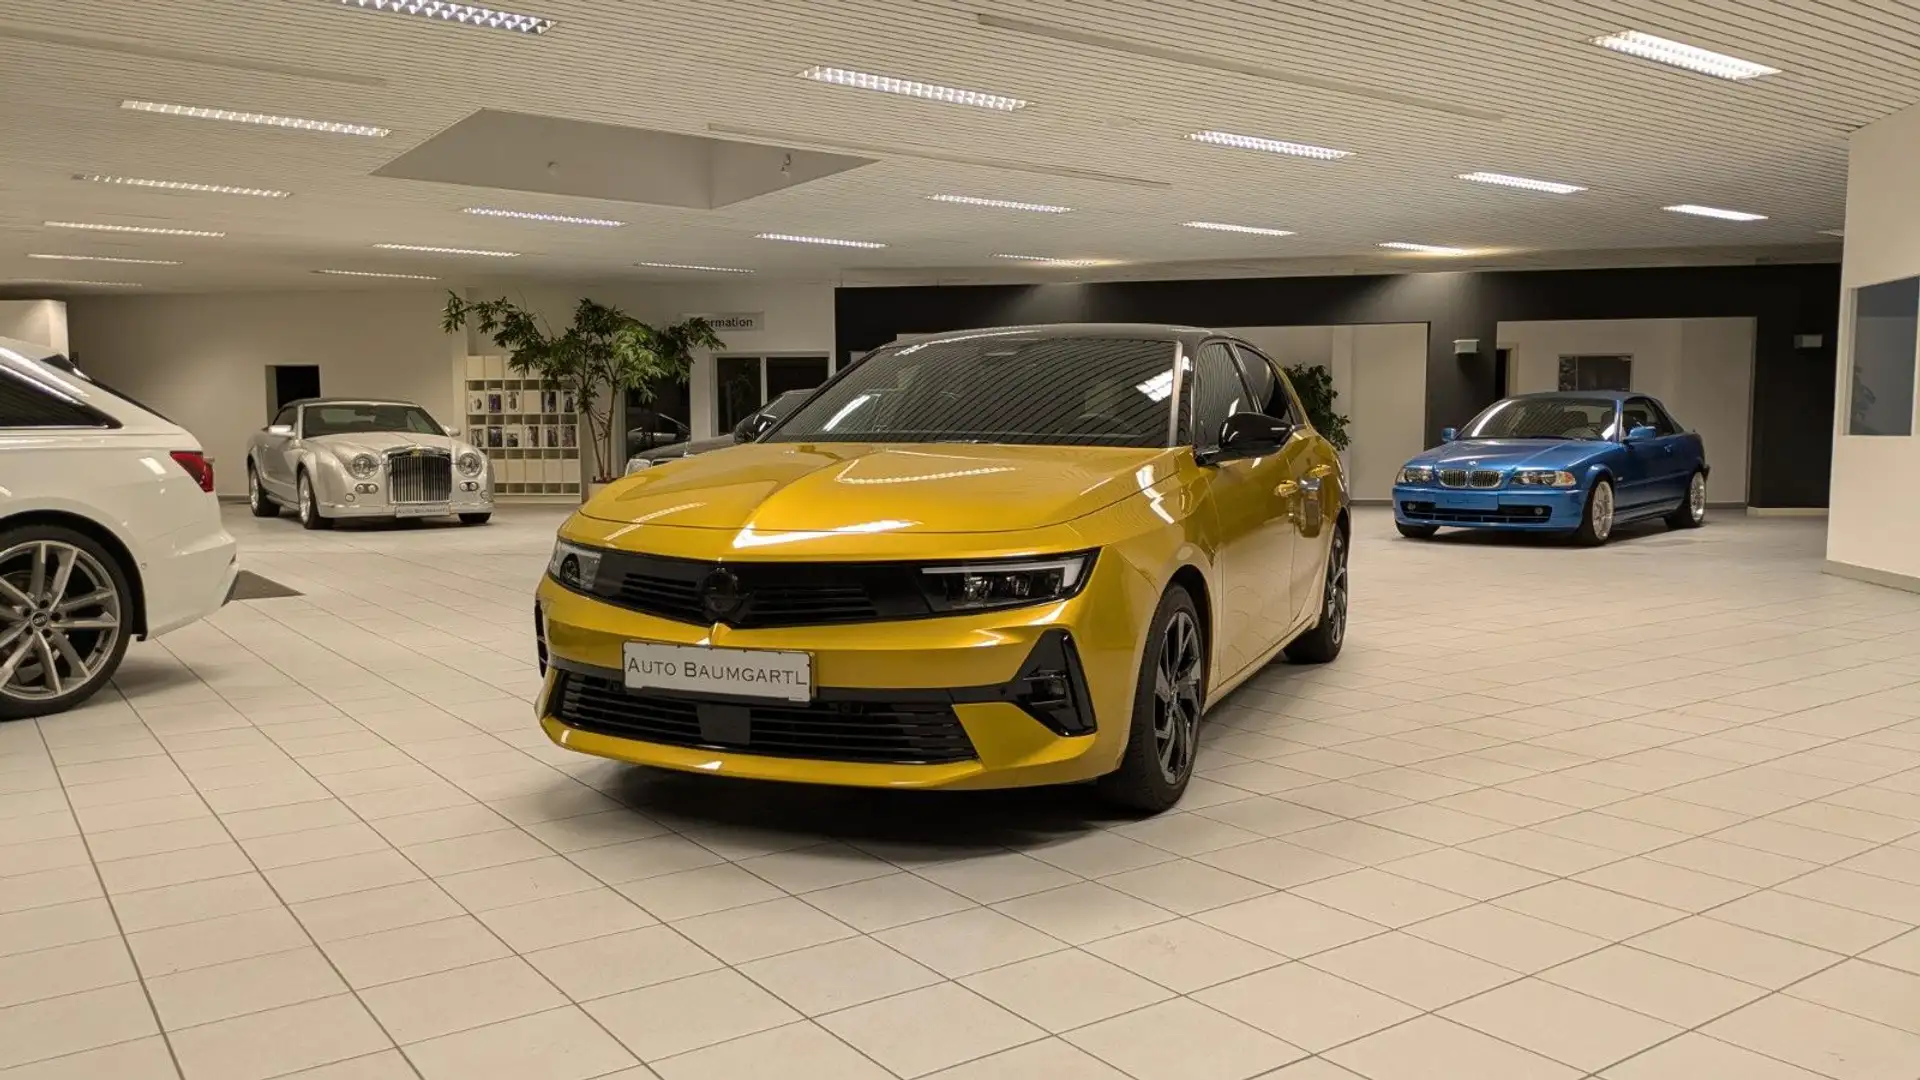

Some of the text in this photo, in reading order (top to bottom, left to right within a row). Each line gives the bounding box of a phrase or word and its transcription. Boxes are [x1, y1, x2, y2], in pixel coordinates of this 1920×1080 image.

[702, 317, 753, 327] ormation
[628, 657, 808, 686] AUTO BAUMGARTL
